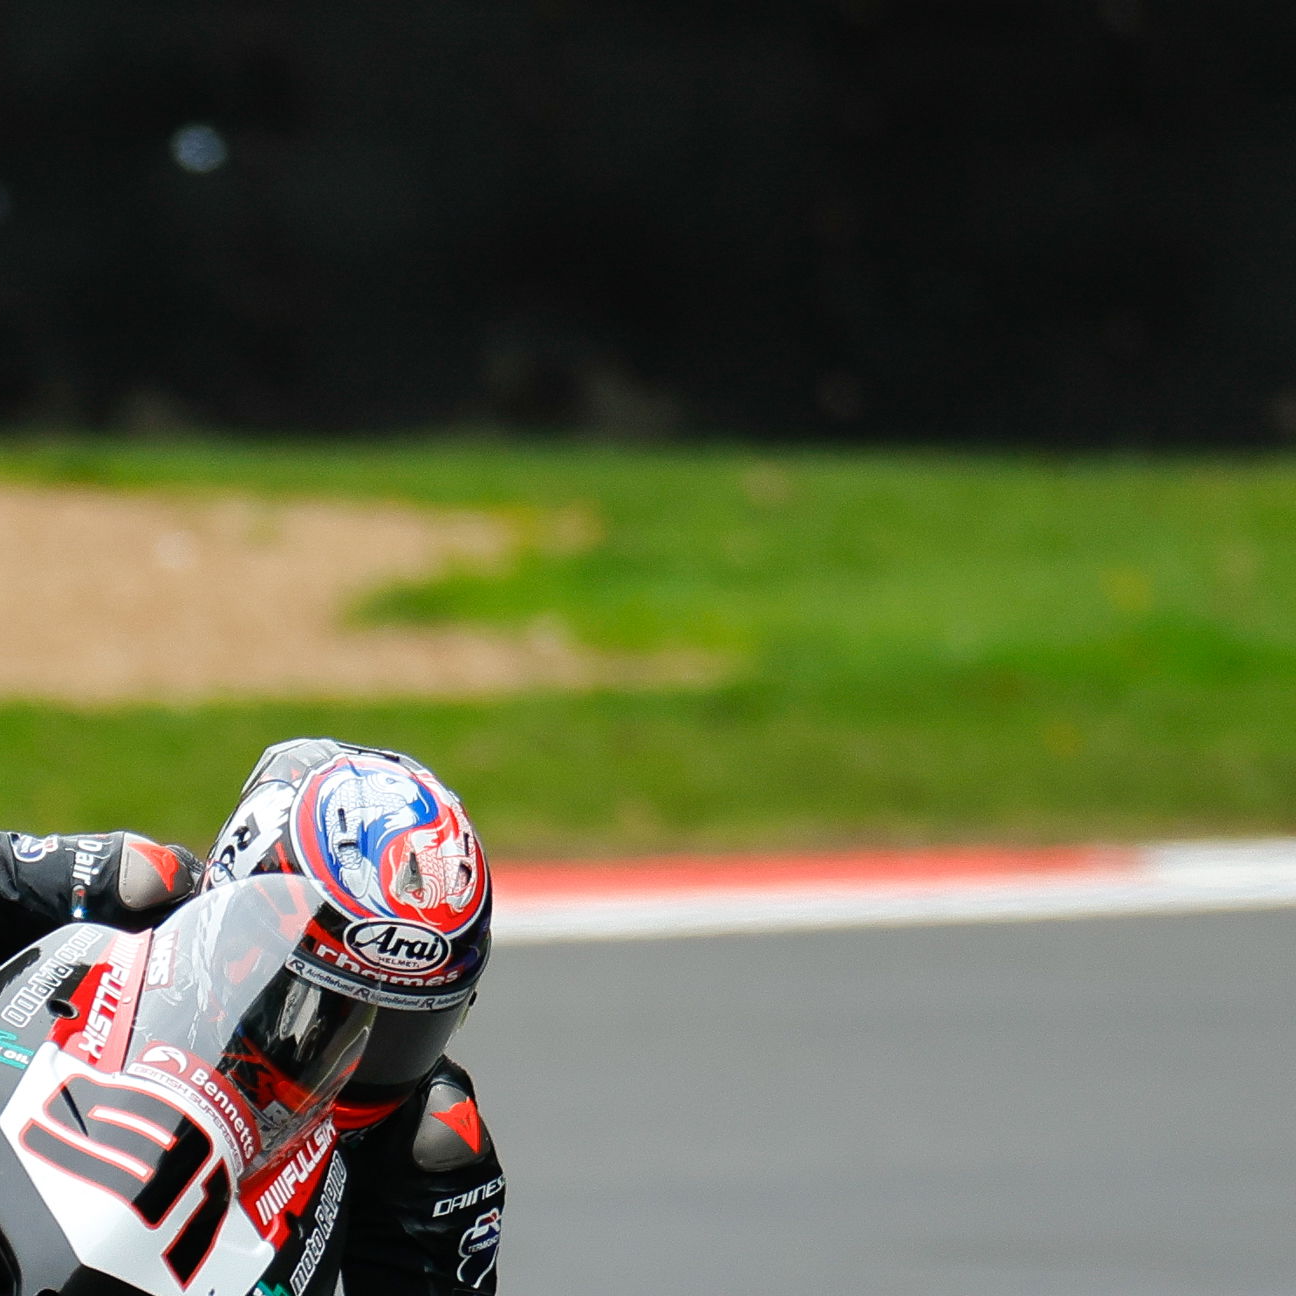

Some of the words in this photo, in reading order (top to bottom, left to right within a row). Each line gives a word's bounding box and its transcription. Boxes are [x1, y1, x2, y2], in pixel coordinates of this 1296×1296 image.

[54, 925, 104, 965] moto
[352, 926, 440, 962] Arai
[378, 955, 420, 968] HELMET
[1, 958, 75, 1028] RAPIDO
[306, 965, 353, 992] AutoRefund
[78, 960, 132, 1060] FULLSIX
[3, 1047, 30, 1065] OIL
[190, 1068, 255, 1160] Bennetts
[281, 1116, 337, 1197] FULLSIX
[314, 1149, 348, 1240] RAPIDO
[432, 1174, 507, 1218] DAINES
